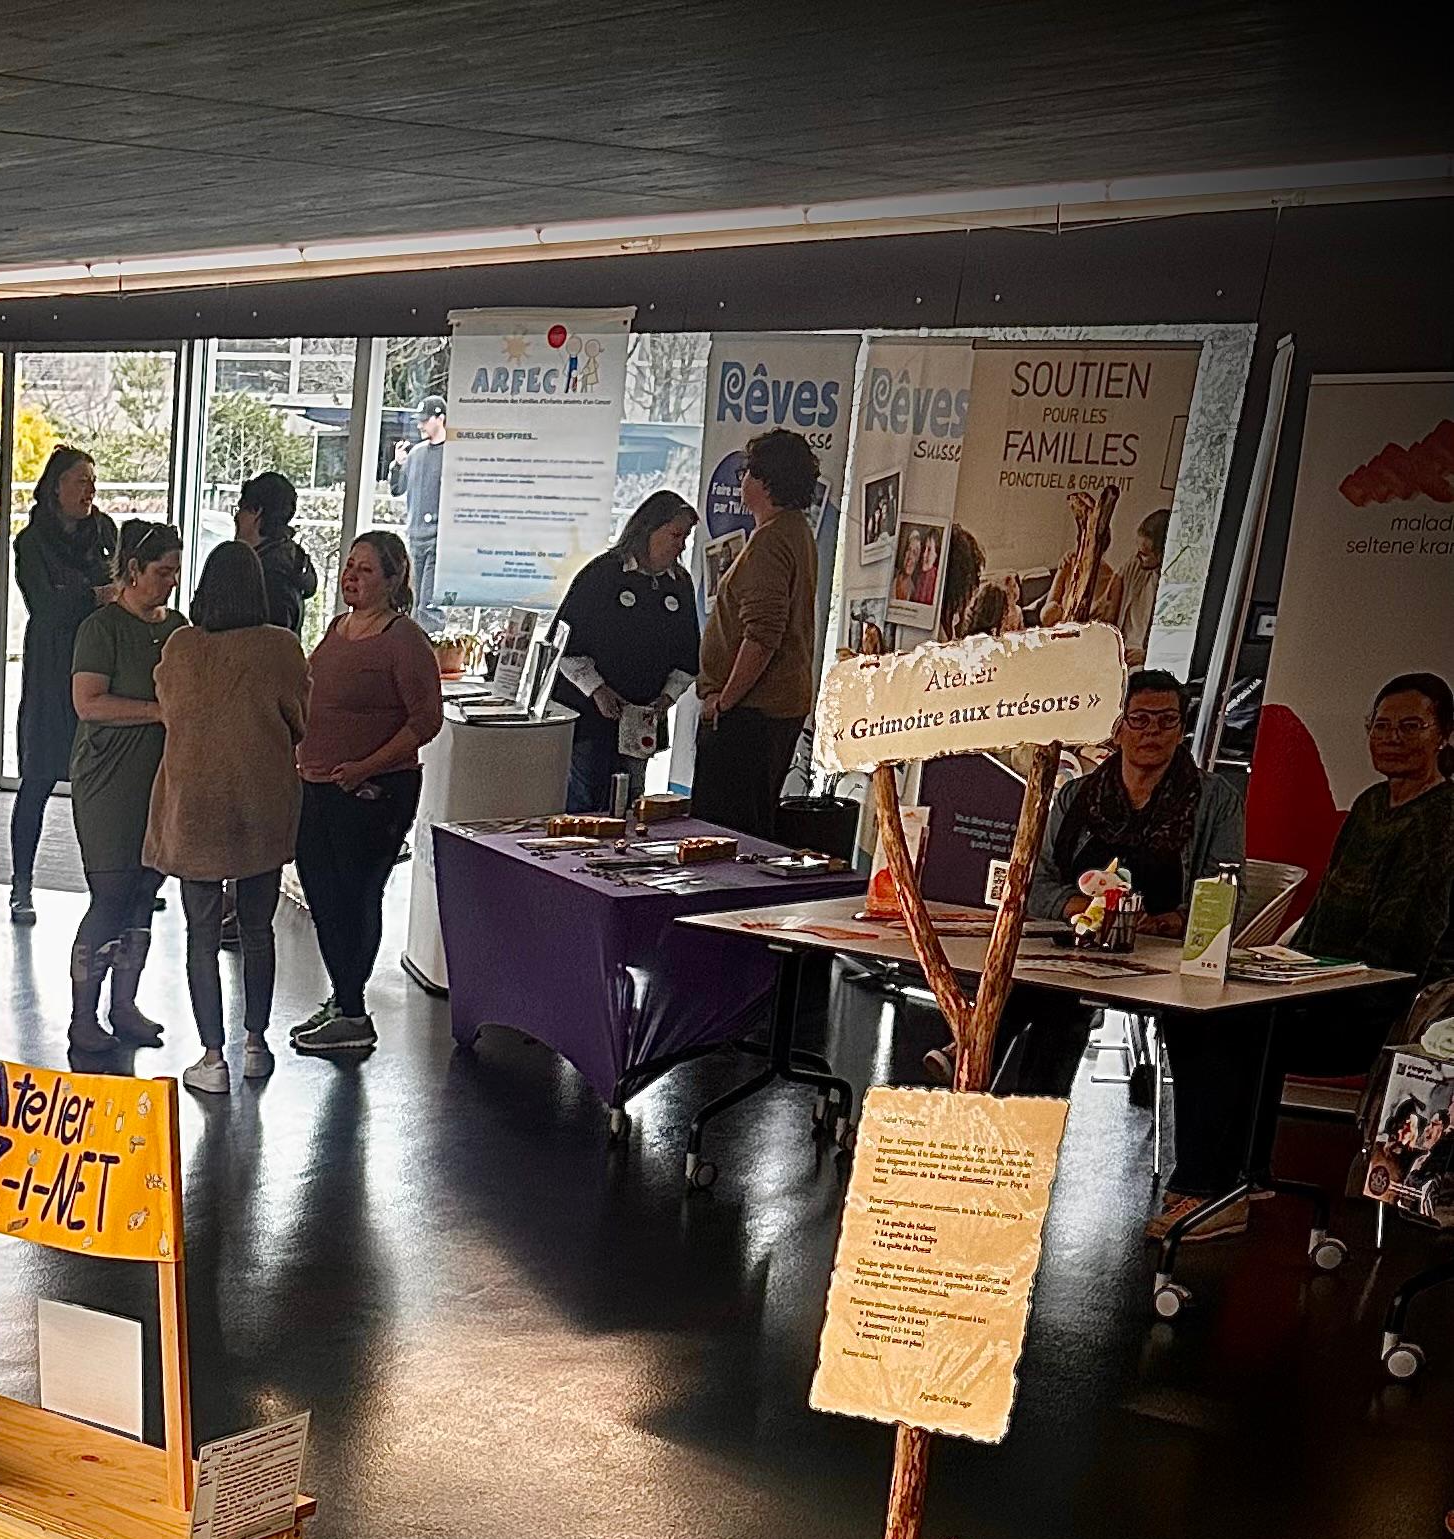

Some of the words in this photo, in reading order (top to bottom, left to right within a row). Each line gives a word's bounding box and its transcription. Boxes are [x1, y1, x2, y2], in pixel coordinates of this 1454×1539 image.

[471, 366, 559, 396] ARFEC
[717, 361, 840, 428] Rêves
[1011, 361, 1151, 399] SOUTIEN
[864, 367, 972, 438] Rêves
[1042, 407, 1079, 423] POUR
[1082, 408, 1107, 424] LES
[914, 440, 961, 463] Suisse
[1003, 430, 1139, 467] FAMILLES
[999, 471, 1065, 489] PONCTUEL
[1067, 474, 1076, 489] &
[1079, 474, 1134, 491] GRATUIT
[1346, 536, 1415, 554] seltene
[924, 665, 998, 692] Ateler
[850, 708, 944, 740] Grimoire
[949, 704, 992, 722] aux
[996, 692, 1080, 718] trésors
